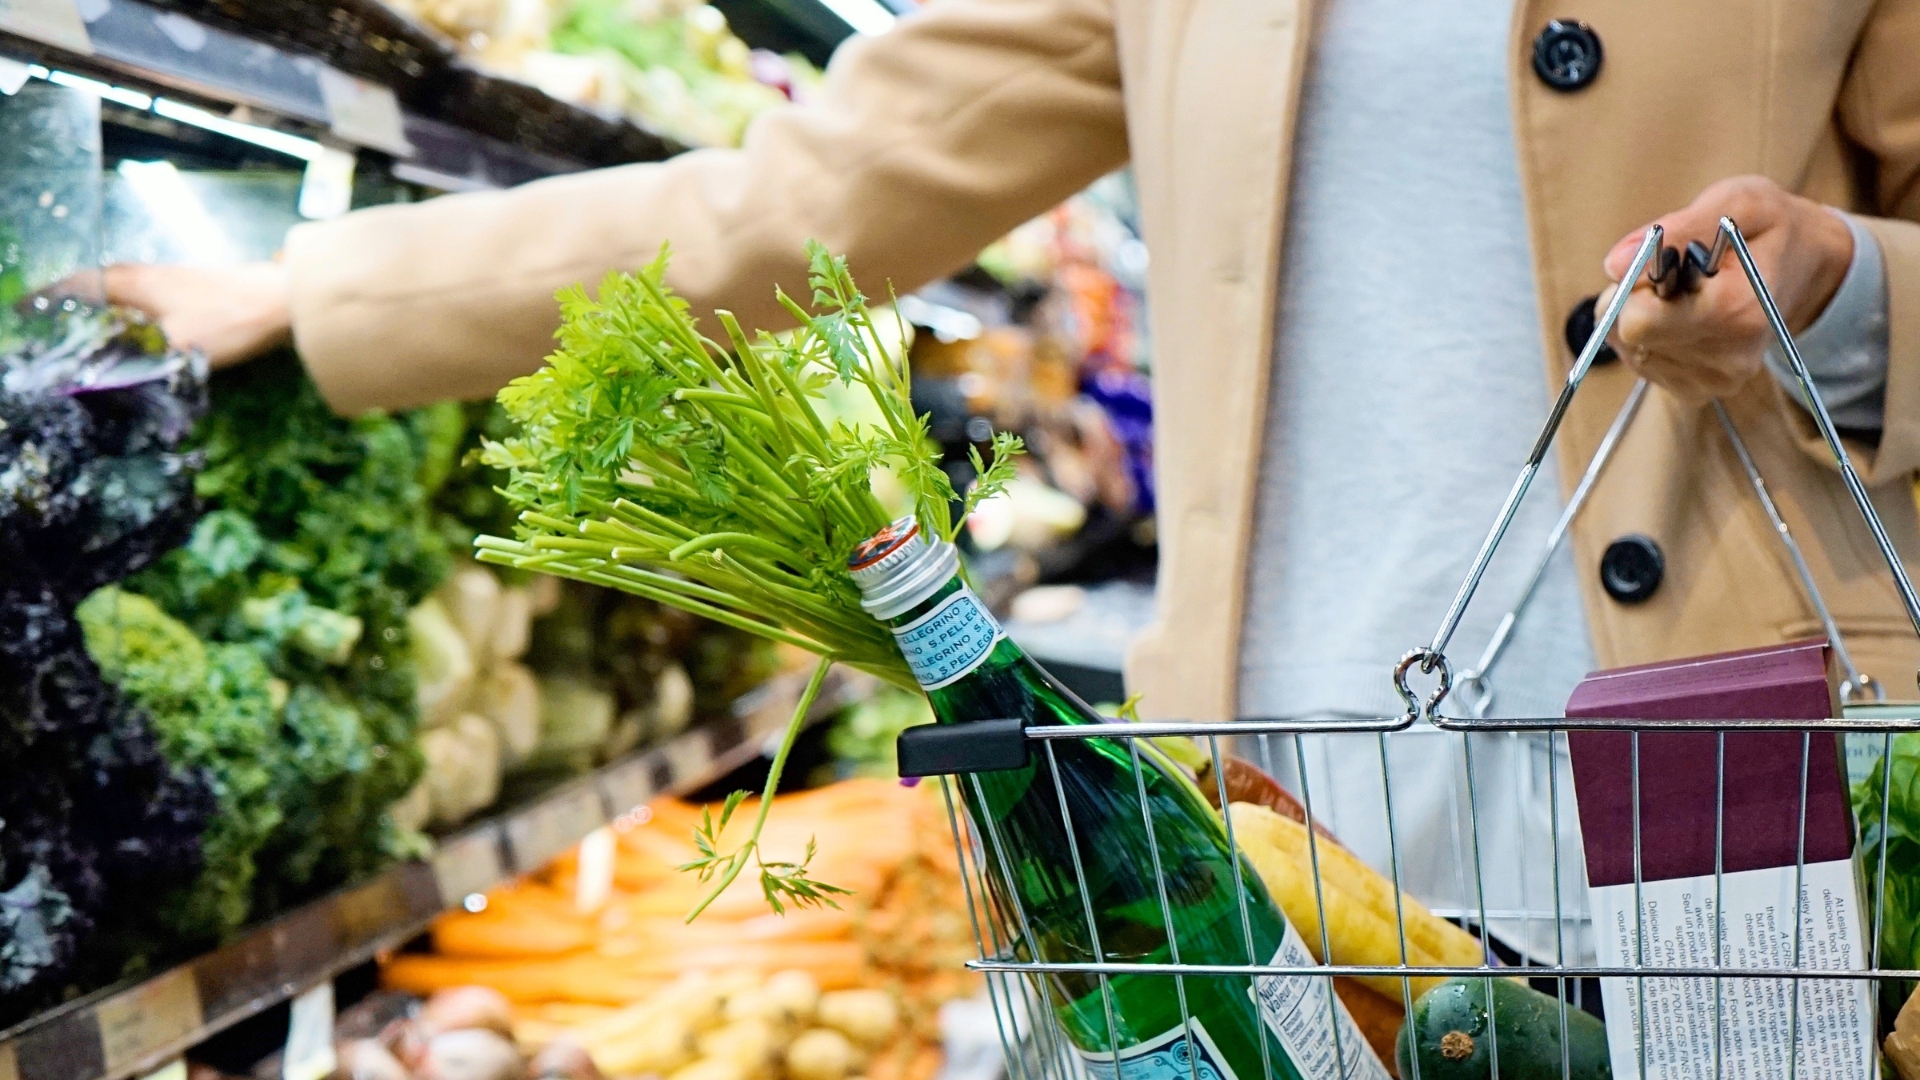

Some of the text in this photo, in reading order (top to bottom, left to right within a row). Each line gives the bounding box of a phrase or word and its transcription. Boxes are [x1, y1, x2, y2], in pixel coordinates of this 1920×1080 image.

[903, 606, 959, 645] ELLEGRINO
[1681, 892, 1693, 914] Seul
[1822, 888, 1835, 929] delicious
[1834, 897, 1843, 907] At
[1616, 910, 1626, 932] vous
[1647, 900, 1661, 943] Délicieux
[1685, 917, 1693, 928] un
[1694, 907, 1704, 929] avec
[1755, 913, 1764, 927] but
[1765, 906, 1776, 932] these
[1834, 910, 1848, 940] Lesley
[1620, 935, 1627, 946] ne
[1744, 913, 1756, 947] cheese
[1779, 931, 1788, 939] A
[1805, 927, 1815, 943] her
[1654, 945, 1661, 957] au
[1685, 931, 1698, 963] produit
[1697, 931, 1707, 953] soin,
[1755, 930, 1768, 954] really
[1767, 934, 1780, 966] unique
[1818, 940, 1826, 955] are
[1828, 932, 1838, 955] food.
[1701, 956, 1708, 967] en
[1721, 944, 1732, 967] Stow
[1749, 949, 1756, 959] or
[1781, 941, 1793, 970] CRIS
[1808, 945, 1818, 969] team
[1691, 965, 1703, 999] aison
[1704, 897, 1713, 909] de
[1721, 1018, 1733, 1057] fabuleux
[1831, 957, 1842, 986] The
[1625, 987, 1636, 1006] plus
[1648, 985, 1657, 997] de
[1681, 977, 1694, 1011] pouvait
[1704, 977, 1714, 1001] etites
[1765, 985, 1775, 1009] when
[1824, 986, 1833, 1005] with
[1661, 997, 1669, 1013] ces
[1671, 992, 1683, 1023] POUR
[1728, 998, 1740, 1027] Foods
[1801, 985, 1813, 1019] scratch
[1814, 997, 1823, 1012] the
[1835, 989, 1848, 1028] fabulous
[1630, 1009, 1639, 1030] vous
[1649, 1000, 1663, 1046] trempette,
[1695, 1002, 1709, 1039] fabriqué
[1746, 1010, 1754, 1025] are
[1757, 1008, 1766, 1024] We
[1779, 1009, 1787, 1026] are
[1815, 1014, 1826, 1034] only
[1827, 1008, 1836, 1029] care
[1848, 999, 1859, 1028] Foods
[1662, 1016, 1677, 1063] craquelins
[1675, 1025, 1686, 1047] CES
[1687, 1013, 1700, 1054] satisfaire
[1748, 1028, 1757, 1048] sure
[1759, 1026, 1768, 1042] are
[1766, 1013, 1780, 1044] topped
[1804, 1021, 1816, 1046] using
[1830, 1031, 1838, 1040] in
[1852, 1030, 1860, 1043] we
[1702, 1041, 1711, 1062] avec
[1733, 1029, 1743, 1056] adore
[1818, 1036, 1828, 1055] way
[1840, 1030, 1851, 1058] crisps
[1657, 1048, 1665, 1060] de
[1679, 1049, 1690, 1073] FINS
[1750, 1051, 1759, 1067] you
[1773, 1046, 1782, 1065] with
[1810, 1048, 1818, 1063] our
[1822, 1057, 1830, 1066] to
[1831, 1042, 1842, 1067] small
[1854, 1046, 1864, 1066] love
